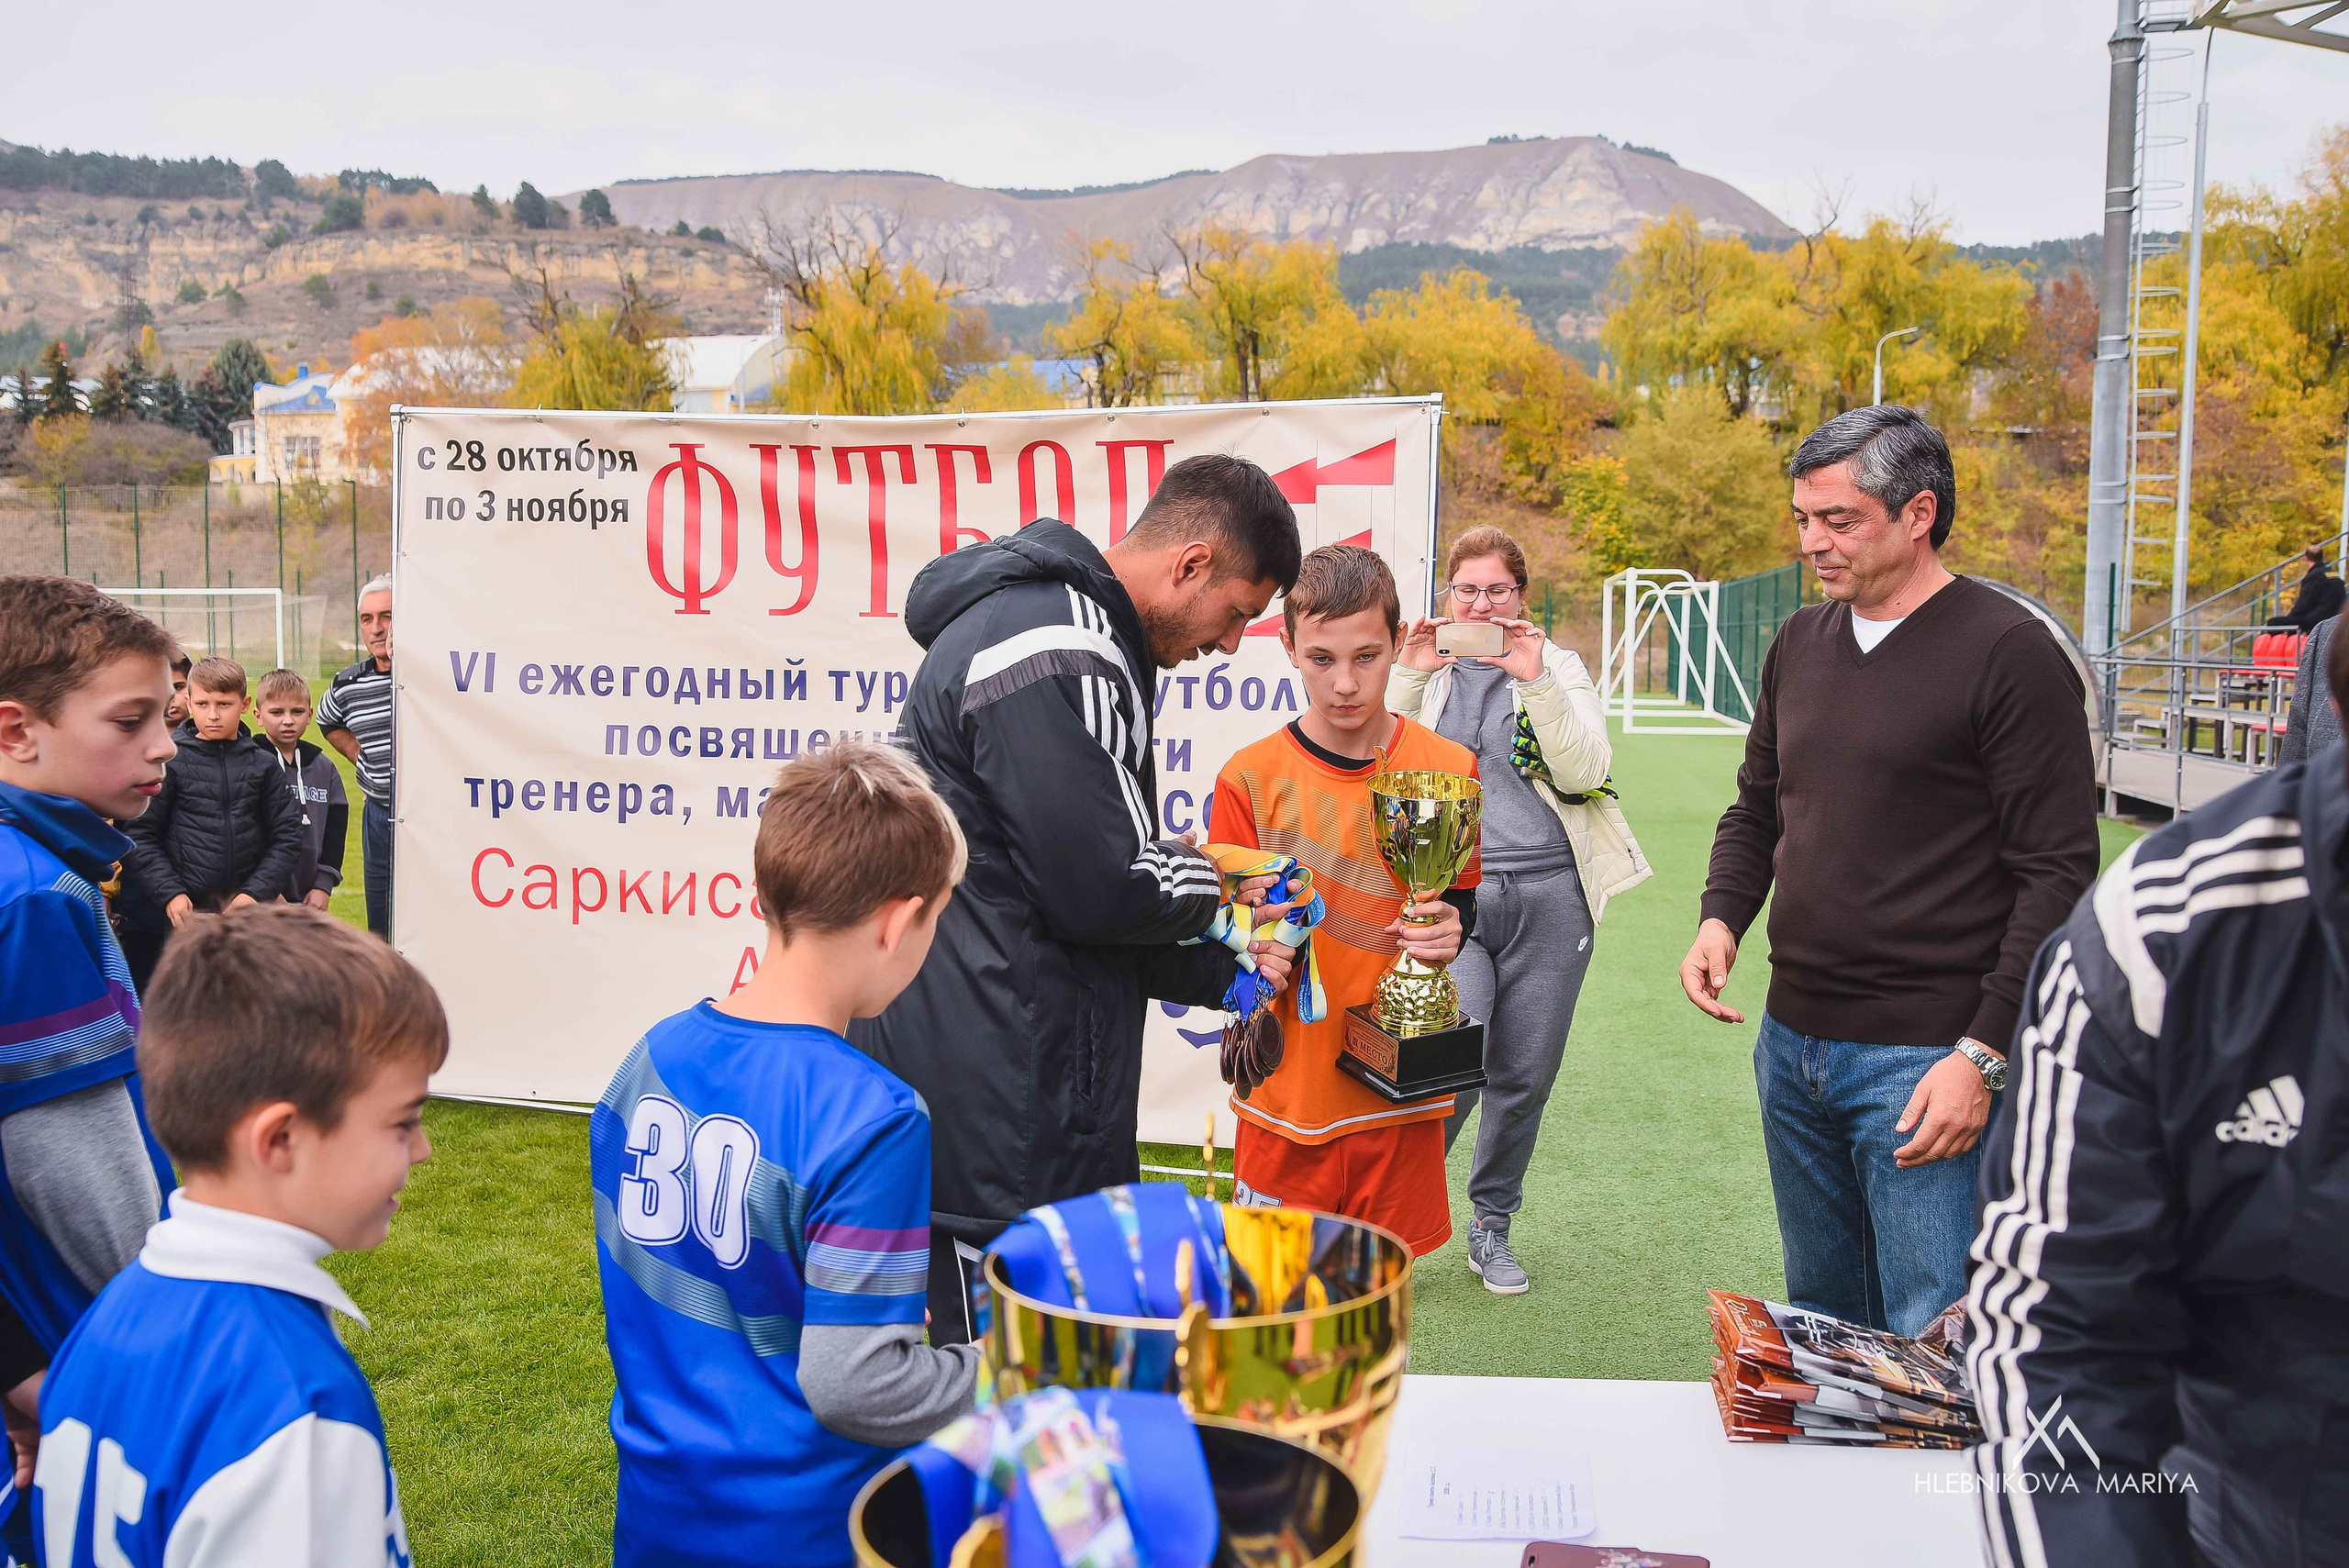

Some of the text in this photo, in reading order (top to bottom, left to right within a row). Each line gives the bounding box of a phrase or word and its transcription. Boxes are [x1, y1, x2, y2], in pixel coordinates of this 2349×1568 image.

[417, 438, 639, 479] с 28 октября
[425, 488, 629, 529] по 3 ноября
[449, 650, 1311, 719] VI ежегодный тур утбол
[463, 775, 692, 825] тренера,
[470, 847, 766, 926] Саркис
[1360, 1040, 1388, 1065] МЕСТО
[618, 1093, 761, 1271] 30
